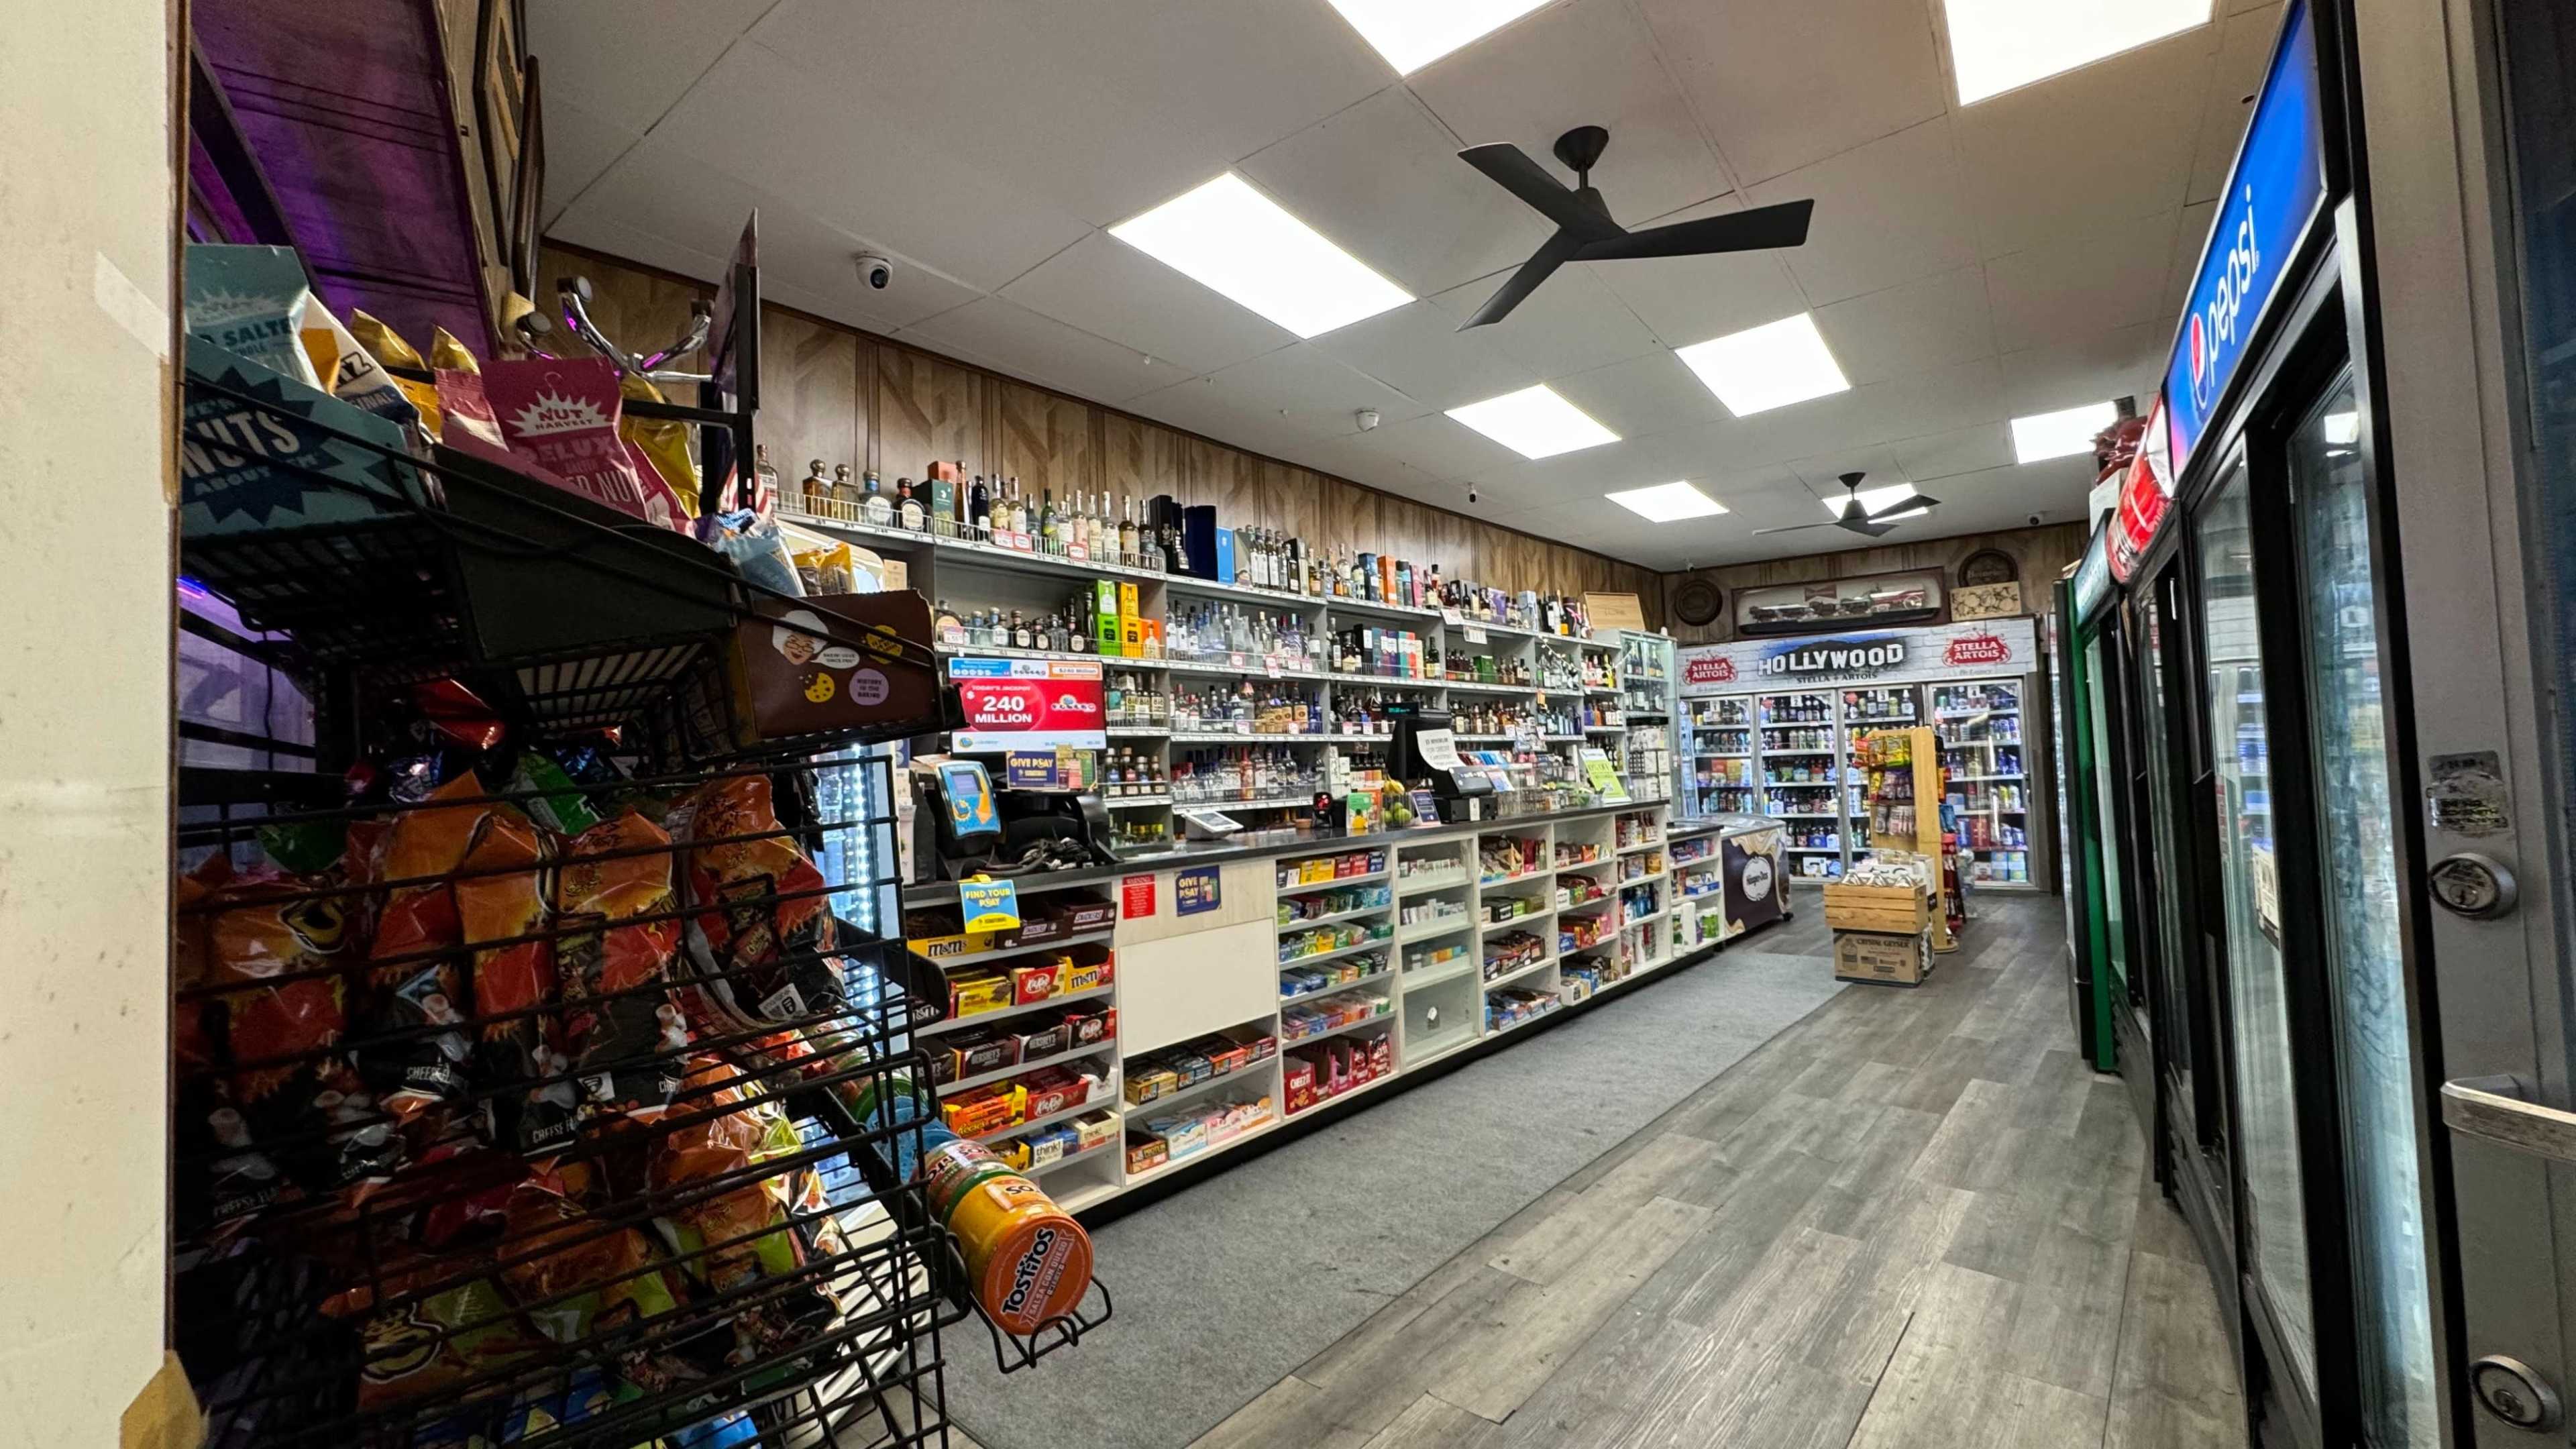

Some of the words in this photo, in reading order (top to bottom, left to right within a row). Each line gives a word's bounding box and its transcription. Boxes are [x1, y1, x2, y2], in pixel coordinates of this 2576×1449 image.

[2208, 183, 2257, 388] pepsi
[223, 317, 291, 346] SALTE
[537, 408, 583, 422] NUT
[535, 418, 593, 431] HARVEST
[1954, 642, 1999, 651] STELLA
[1758, 643, 1904, 676] HOLLYWOOD
[1954, 650, 2000, 660] ARTOIS
[1692, 662, 1728, 670] STELLA
[1692, 670, 1729, 679] ARTOIS
[1797, 676, 1829, 684] STELLA
[1840, 672, 1878, 681] ARTOIS
[966, 690, 975, 700] $
[983, 695, 1025, 712] 240
[975, 713, 1032, 724] MILLION
[1010, 758, 1031, 767] GIVE
[1179, 877, 1197, 888] GIVE
[966, 890, 985, 899] FIND
[987, 888, 1010, 897] YOUR
[1036, 1141, 1061, 1157] think!
[1029, 1288, 1046, 1315] SALSA
[1042, 1268, 1053, 1287] CON
[1051, 1241, 1067, 1267] QUESO
